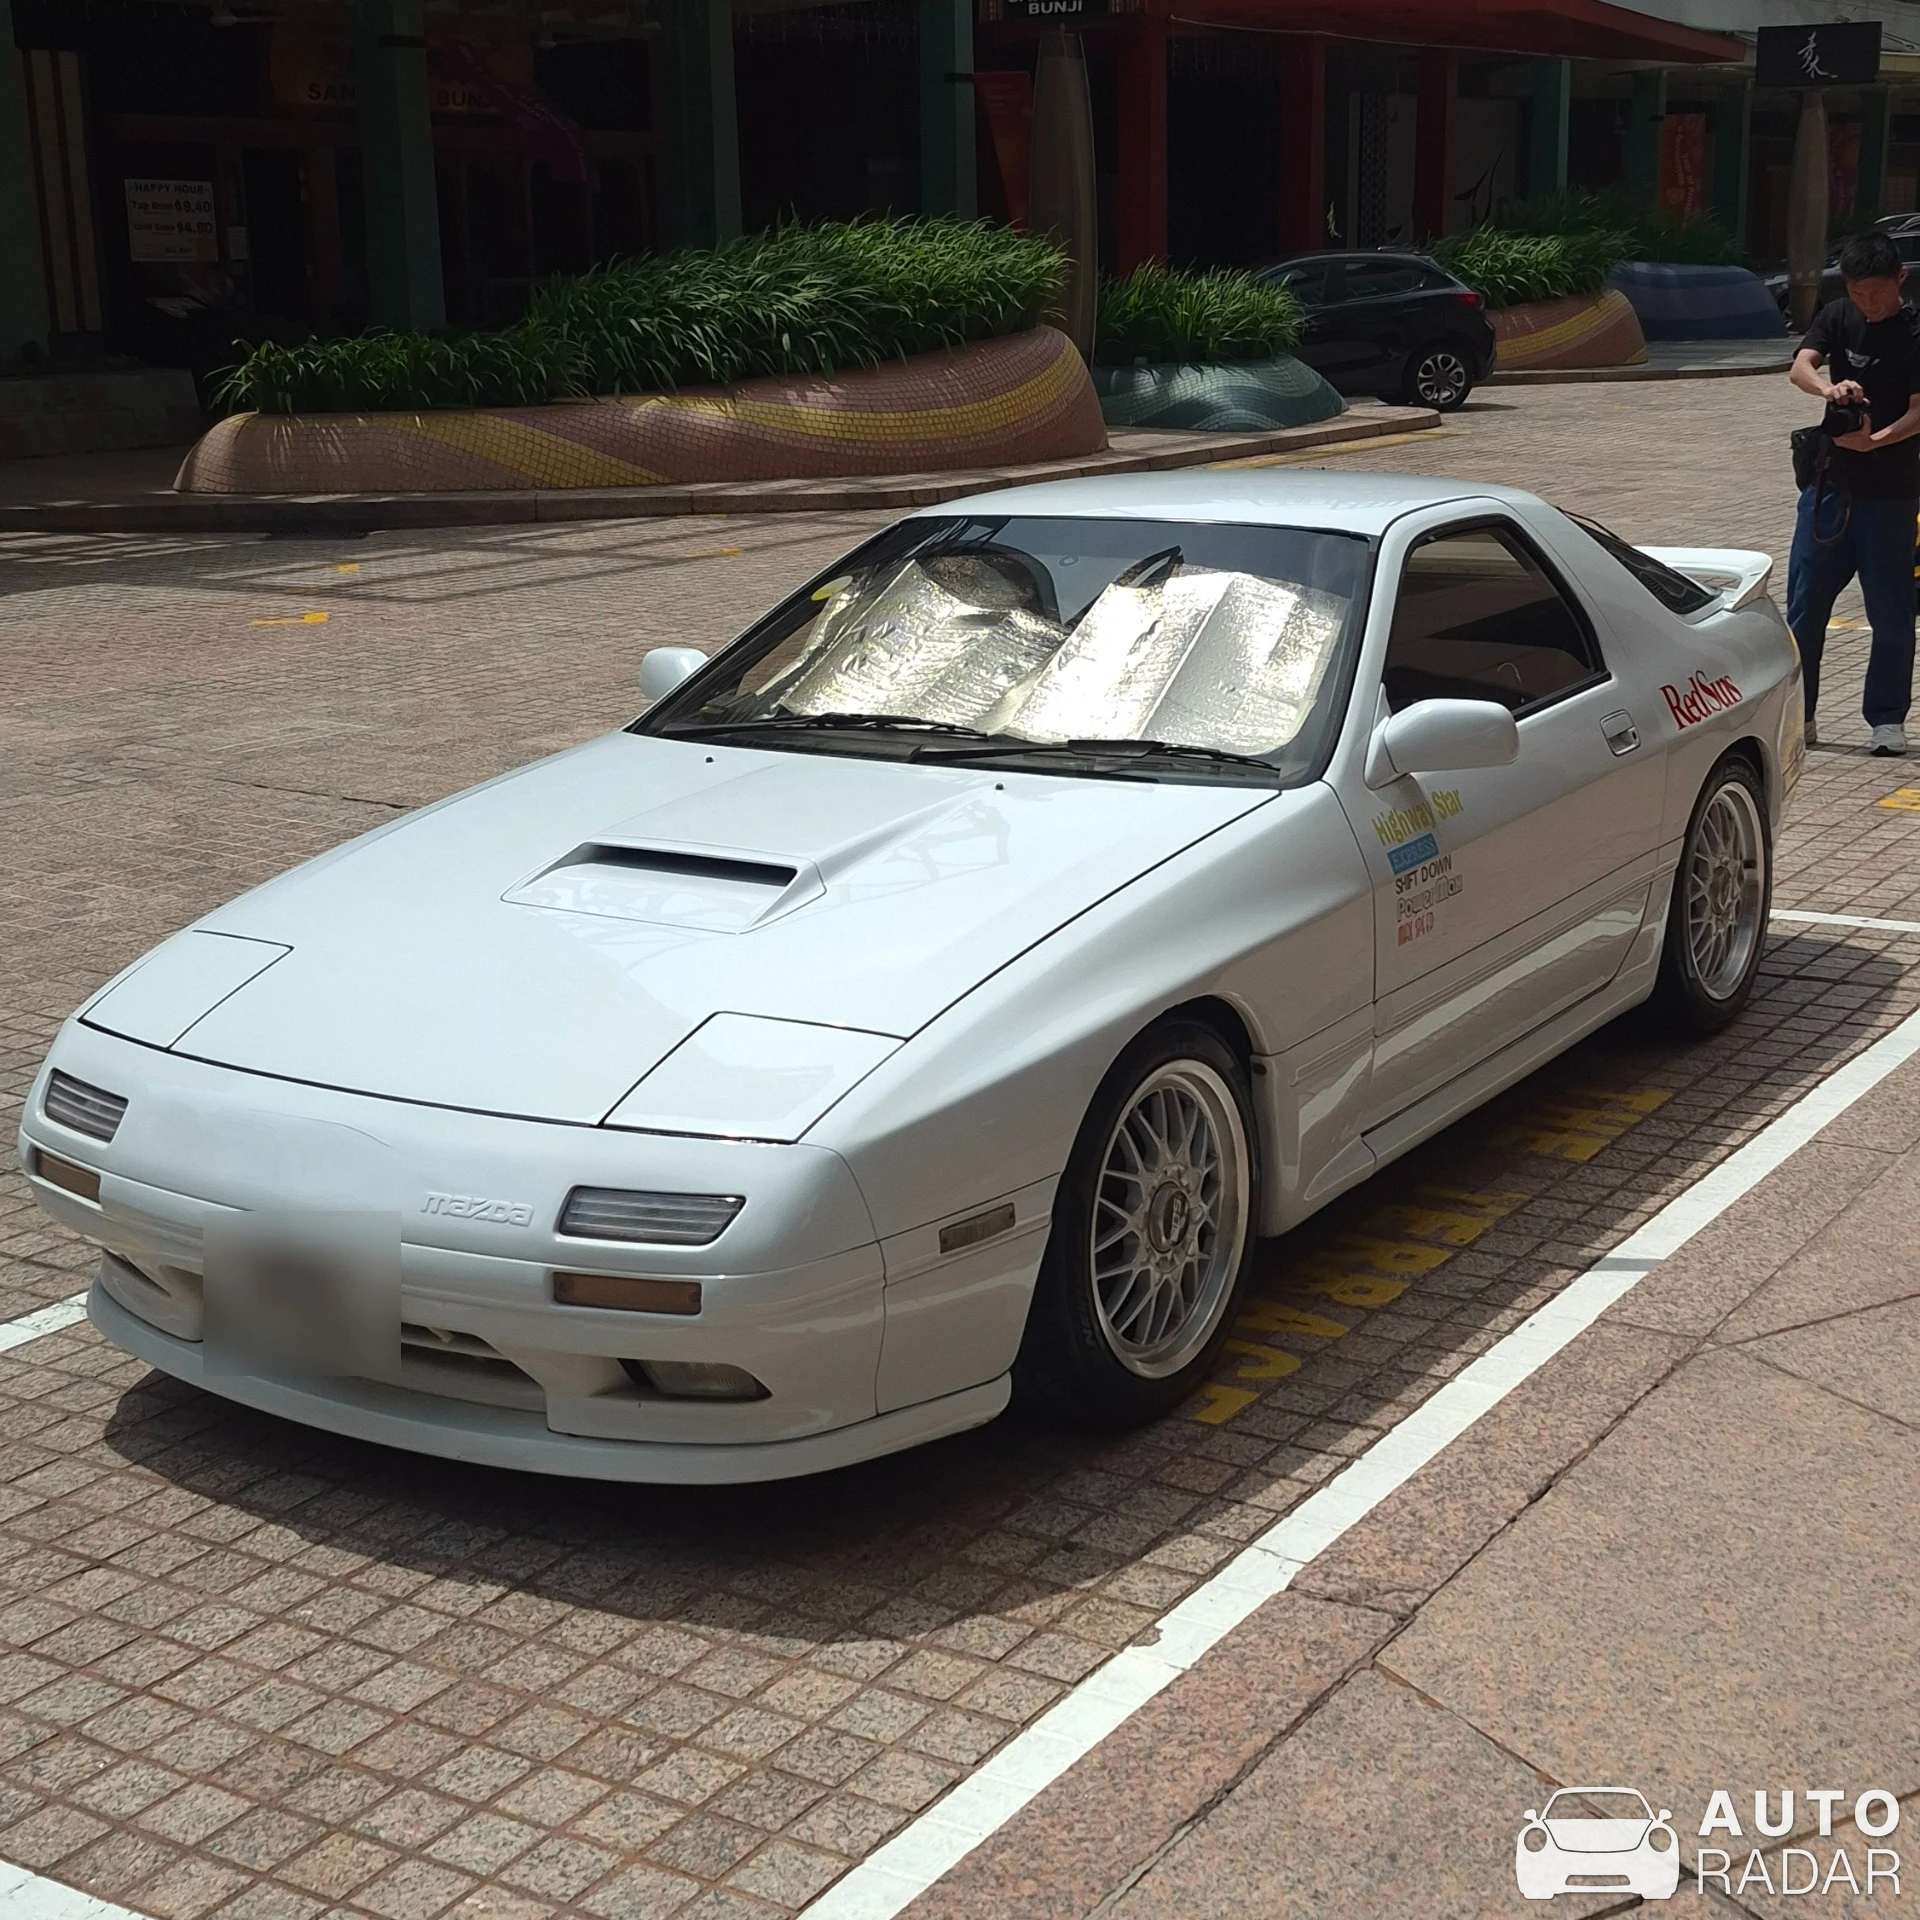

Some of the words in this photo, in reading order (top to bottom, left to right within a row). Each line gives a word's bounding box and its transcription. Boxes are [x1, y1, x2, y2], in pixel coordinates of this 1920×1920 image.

[1028, 0, 1083, 15] BUNJI
[134, 182, 170, 193] HAPPY
[174, 183, 204, 194] HOUR
[1659, 669, 1743, 731] RedSuns
[1372, 803, 1436, 846] Highway
[1431, 788, 1465, 820] Star
[1391, 836, 1438, 870] EXPRESS
[1395, 870, 1419, 895] SHIFT
[1421, 854, 1453, 883] DOWN
[420, 1191, 535, 1228] mazda
